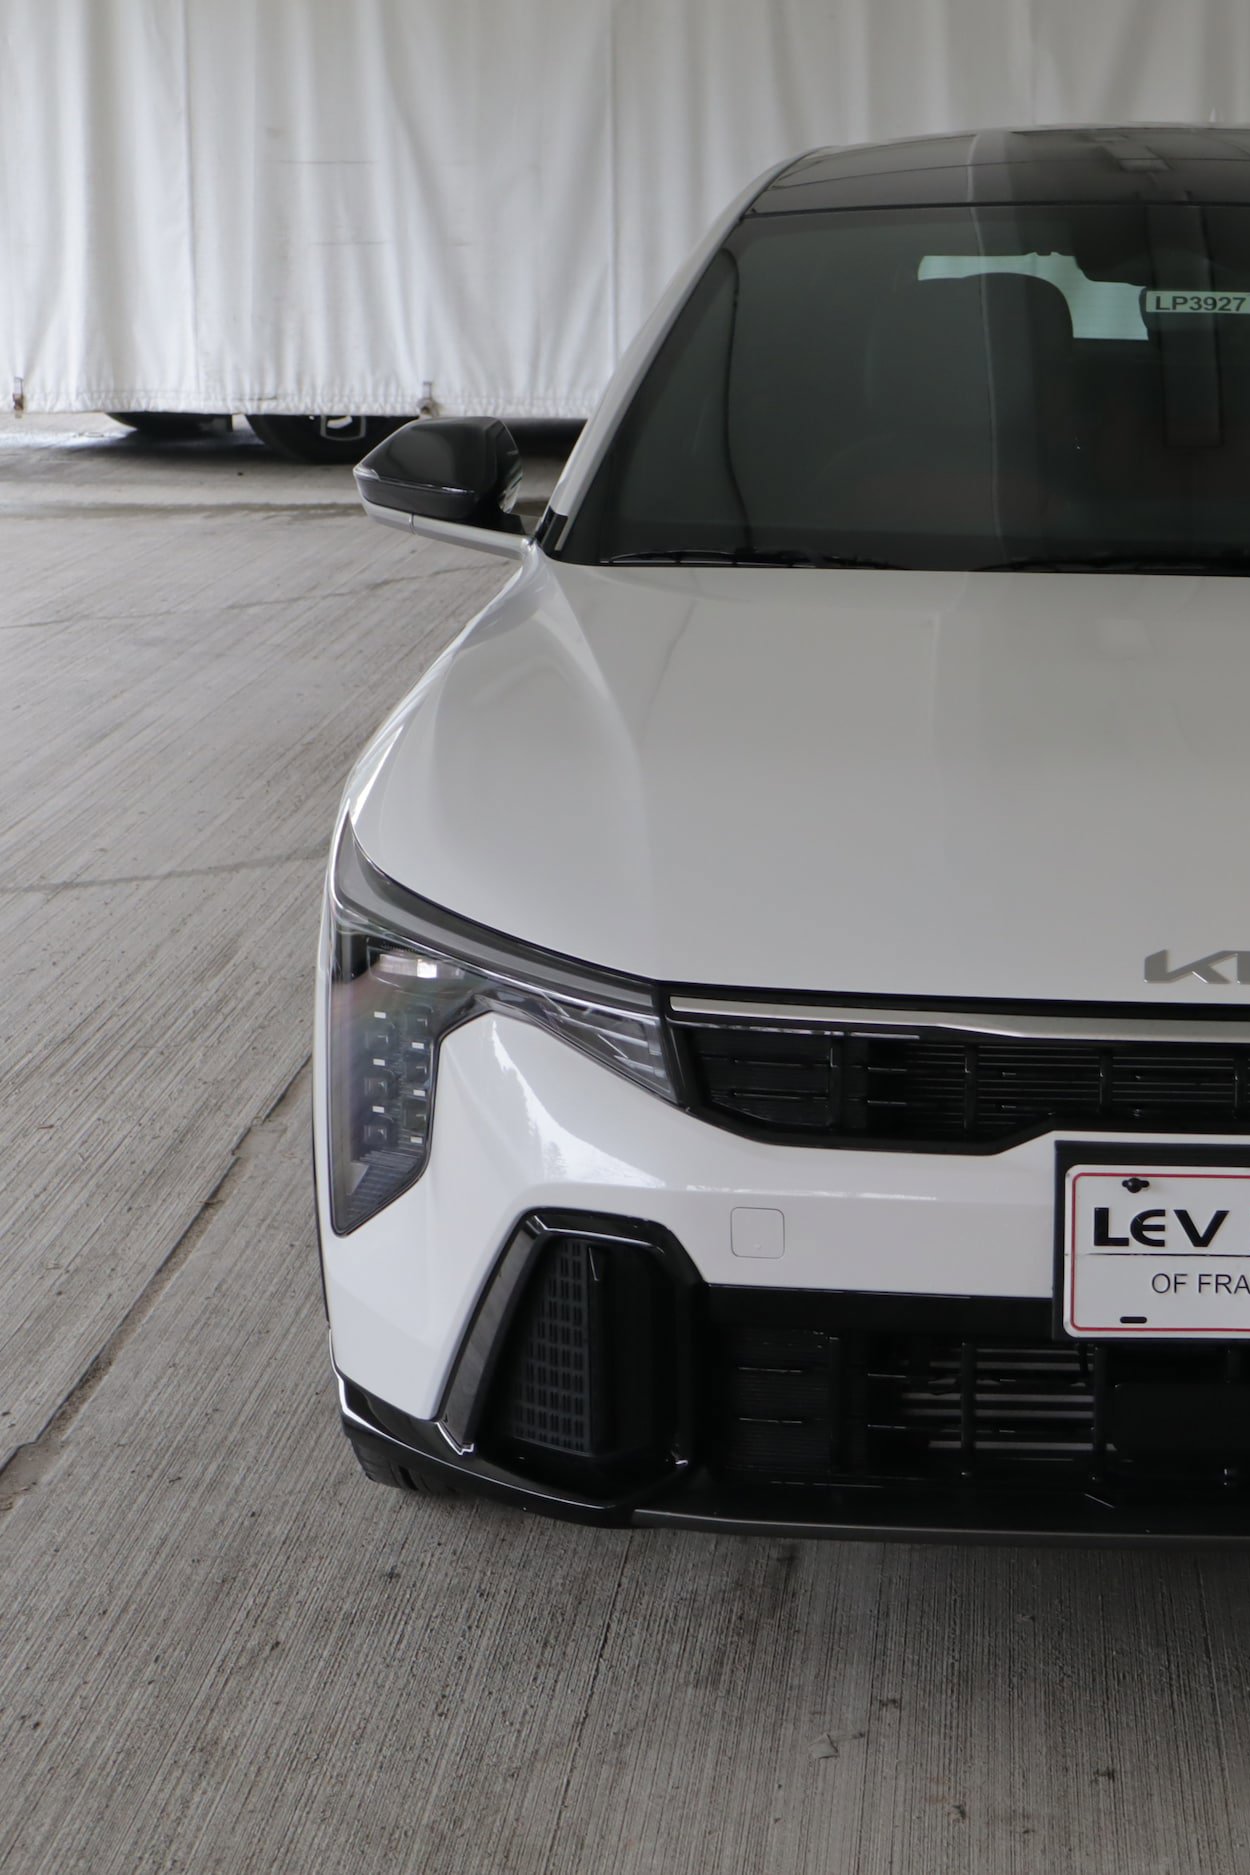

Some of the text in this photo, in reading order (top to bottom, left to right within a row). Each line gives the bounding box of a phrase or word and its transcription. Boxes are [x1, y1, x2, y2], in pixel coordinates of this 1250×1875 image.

[1155, 295, 1246, 312] LP3927
[1093, 1207, 1230, 1248] LEV
[1151, 1272, 1188, 1295] OF
